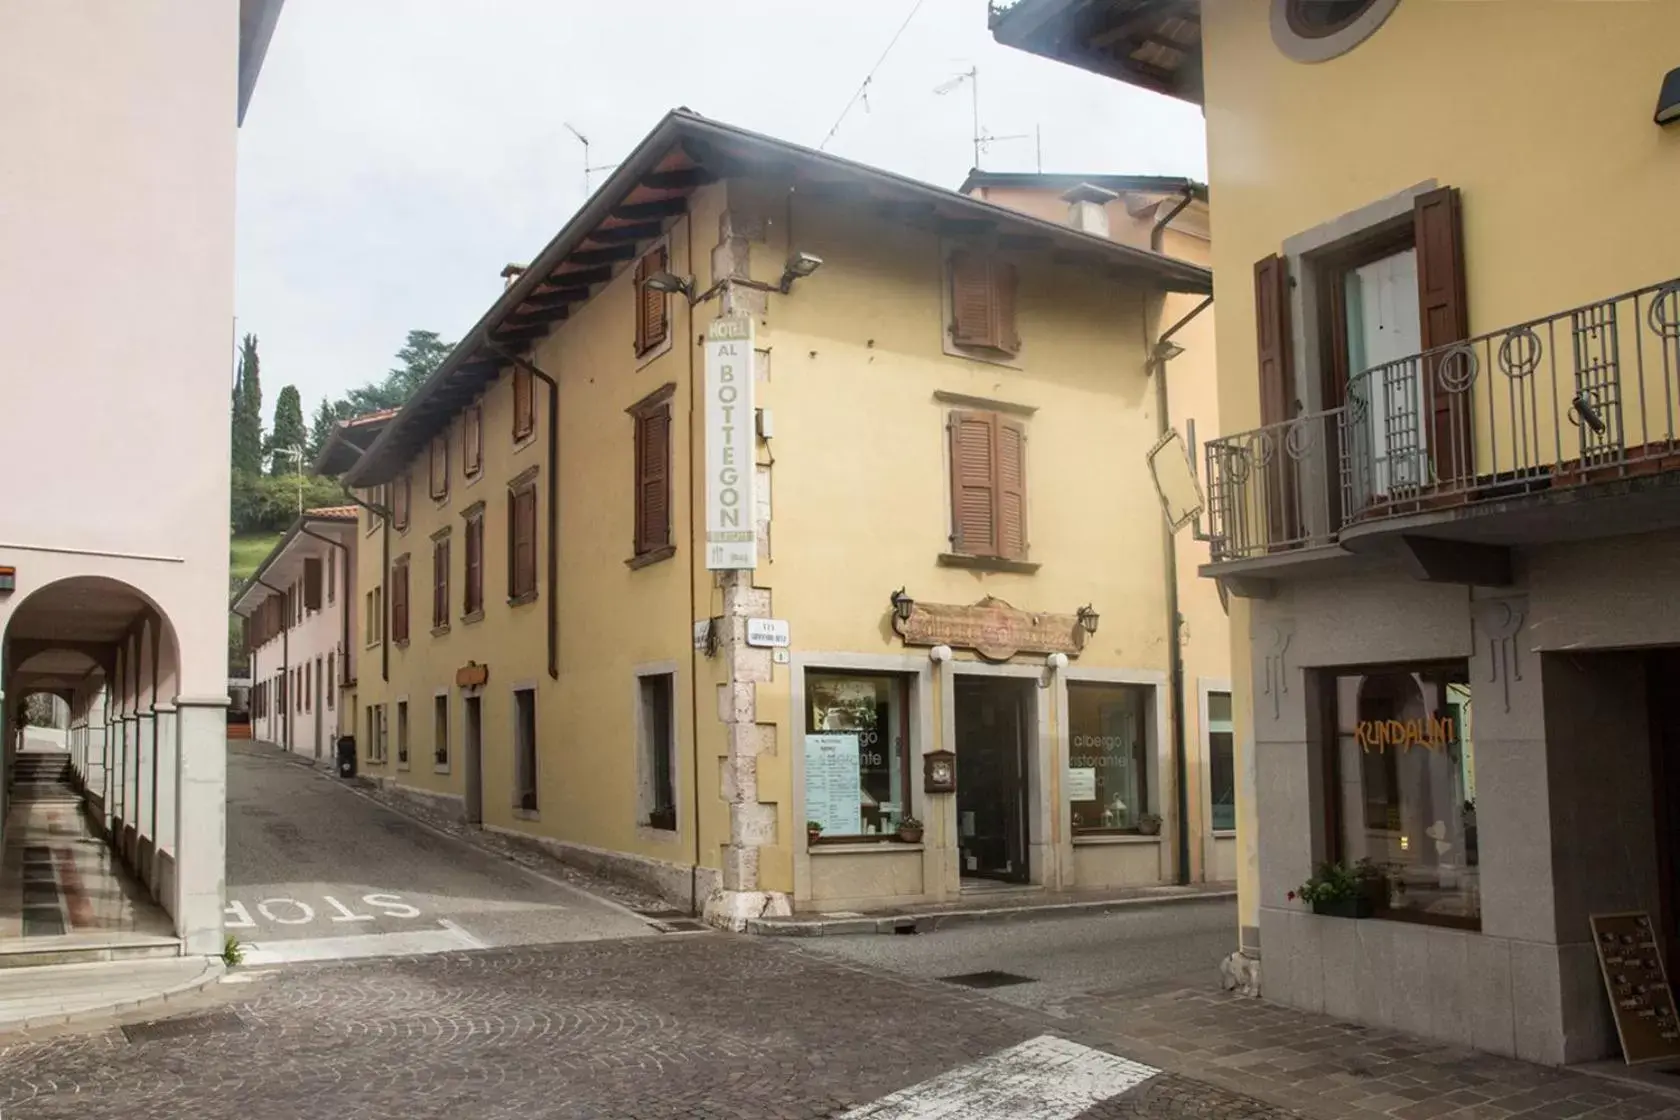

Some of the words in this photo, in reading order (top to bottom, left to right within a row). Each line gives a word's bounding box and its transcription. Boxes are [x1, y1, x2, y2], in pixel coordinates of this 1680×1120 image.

[718, 343, 738, 357] AL
[718, 364, 740, 528] BOTTEGON
[1074, 732, 1122, 751] albergo
[1355, 711, 1453, 754] KUNDALINI
